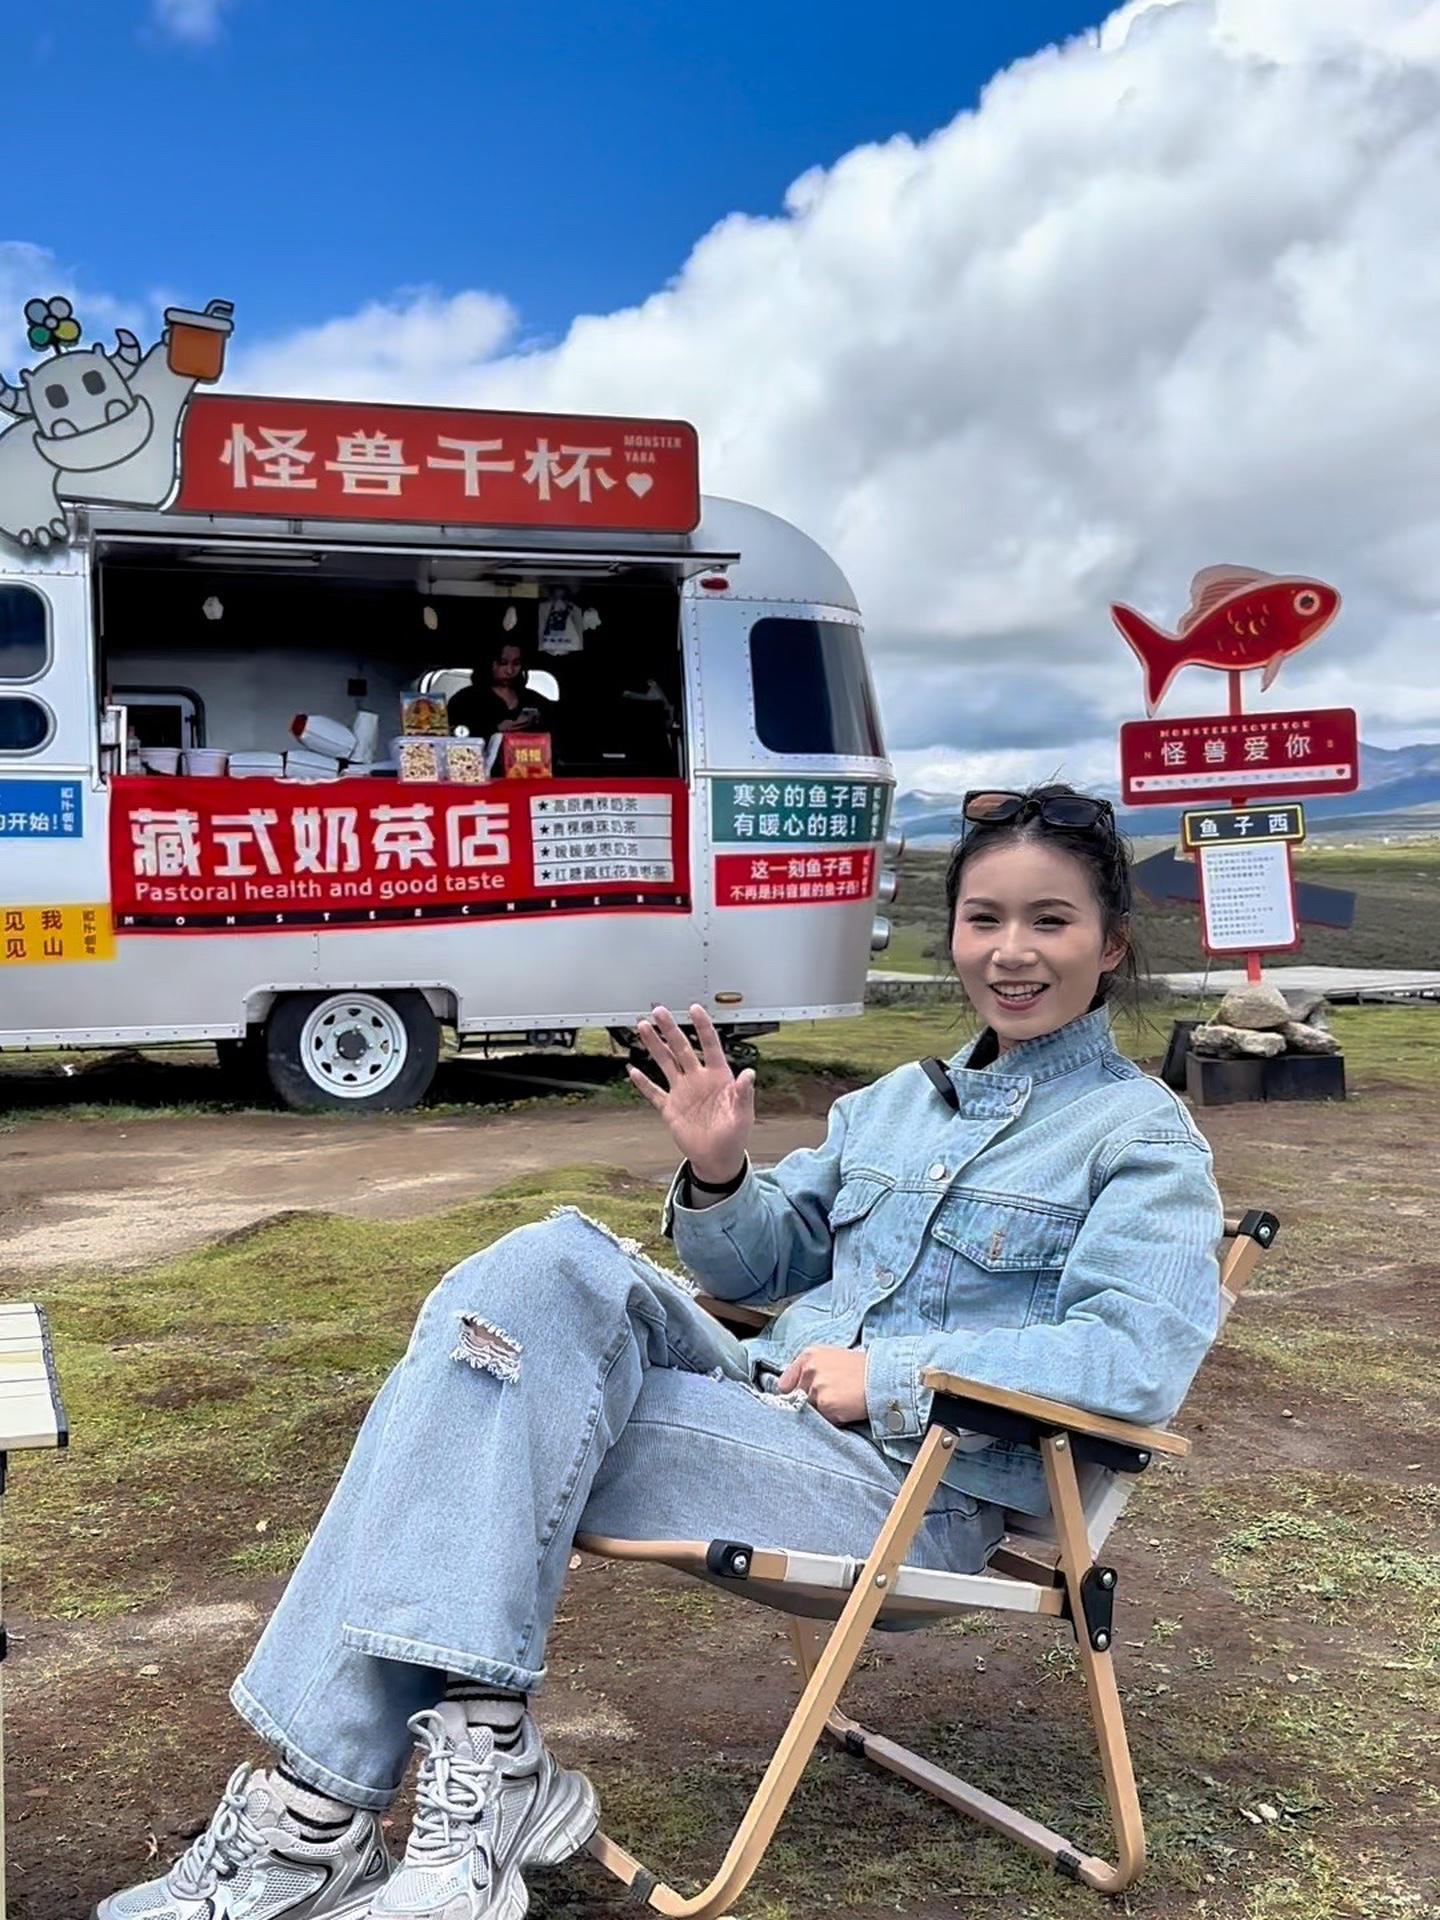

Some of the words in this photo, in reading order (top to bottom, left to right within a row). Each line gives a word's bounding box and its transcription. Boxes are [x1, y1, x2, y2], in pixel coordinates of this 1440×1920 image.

[624, 434, 682, 449] MONSTER
[219, 422, 618, 503] 怪兽干杯
[1282, 720, 1312, 730] YOU
[1161, 733, 1312, 767] 怪兽爱你
[733, 784, 868, 808] 寒冷的鱼子西
[1200, 813, 1288, 838] 鱼子西
[128, 800, 511, 877] 藏式奶茶店
[751, 856, 853, 880] 这一刻鱼子西
[135, 881, 237, 902] Pastoral
[244, 878, 322, 900] health
[329, 876, 373, 897] and
[380, 874, 438, 899] good
[444, 872, 506, 893] taste
